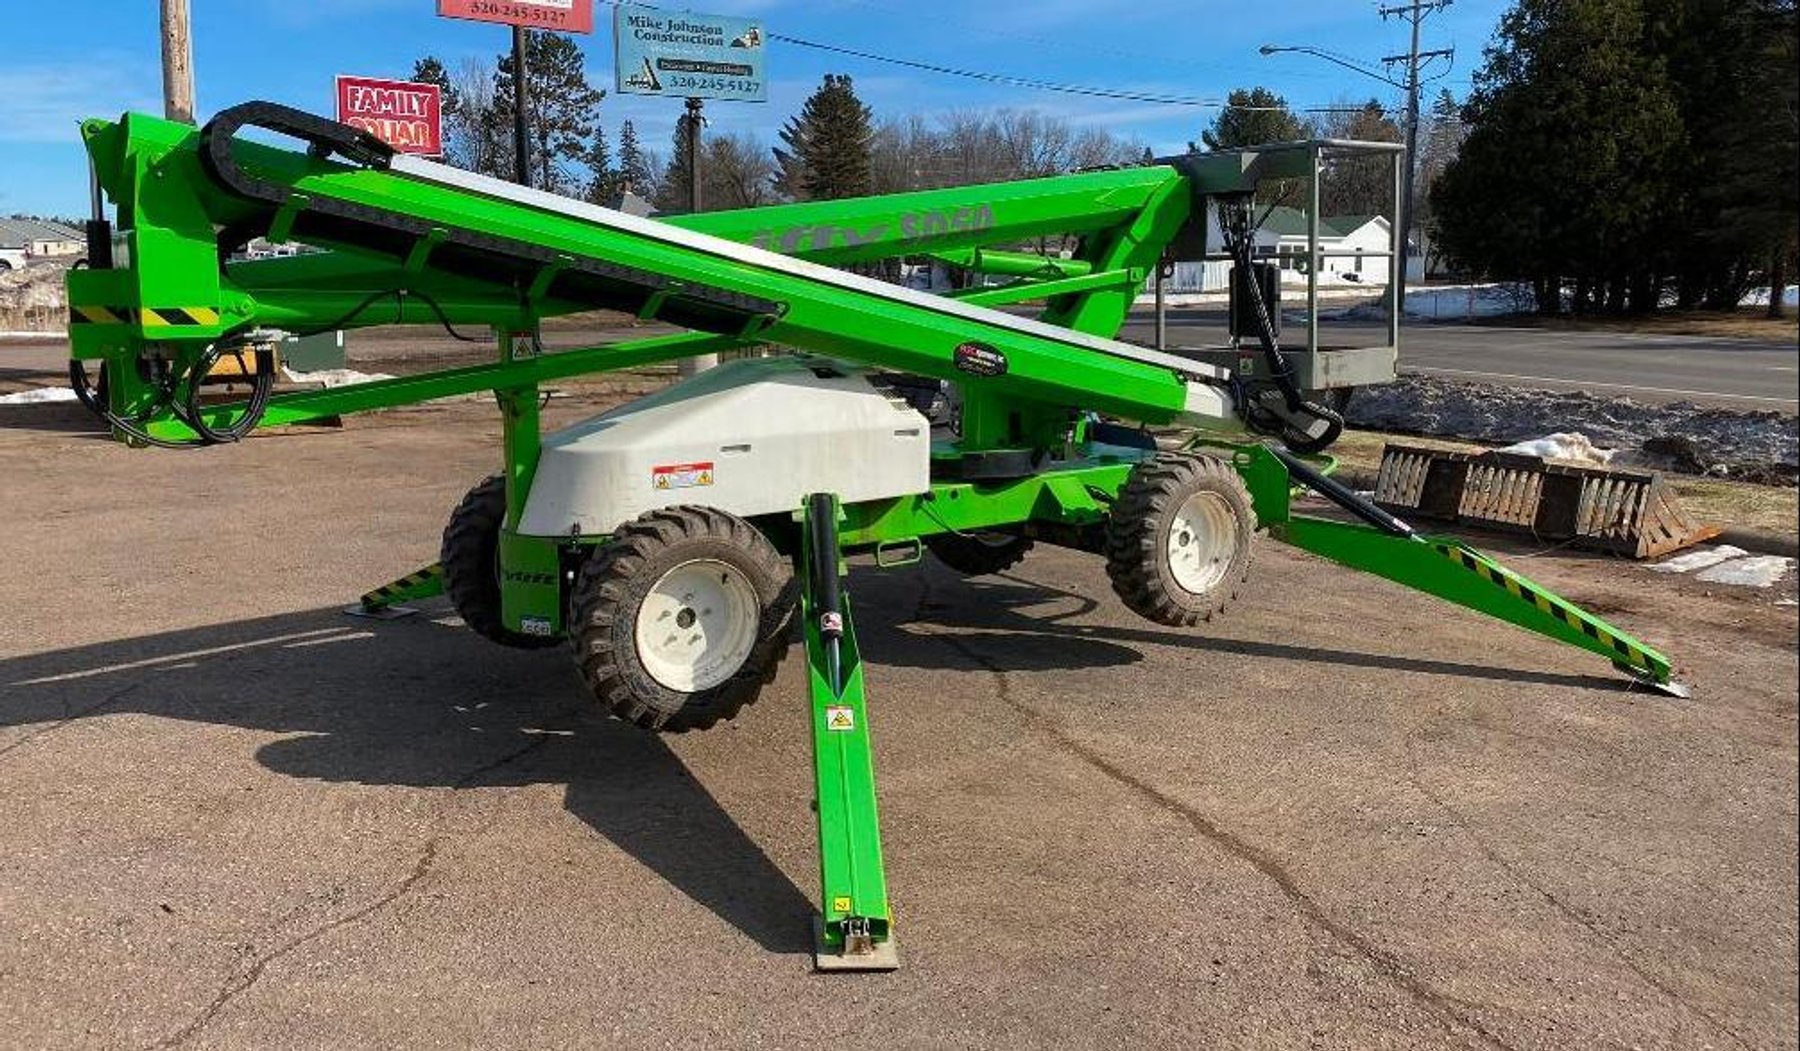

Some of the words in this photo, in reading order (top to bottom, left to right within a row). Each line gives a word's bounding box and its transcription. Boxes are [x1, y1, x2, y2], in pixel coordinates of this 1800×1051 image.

[627, 15, 662, 30] Mike
[667, 19, 723, 36] Johnson
[634, 29, 724, 47] Construction
[669, 75, 760, 93] 320-245-5127
[347, 86, 431, 117] FAMILY
